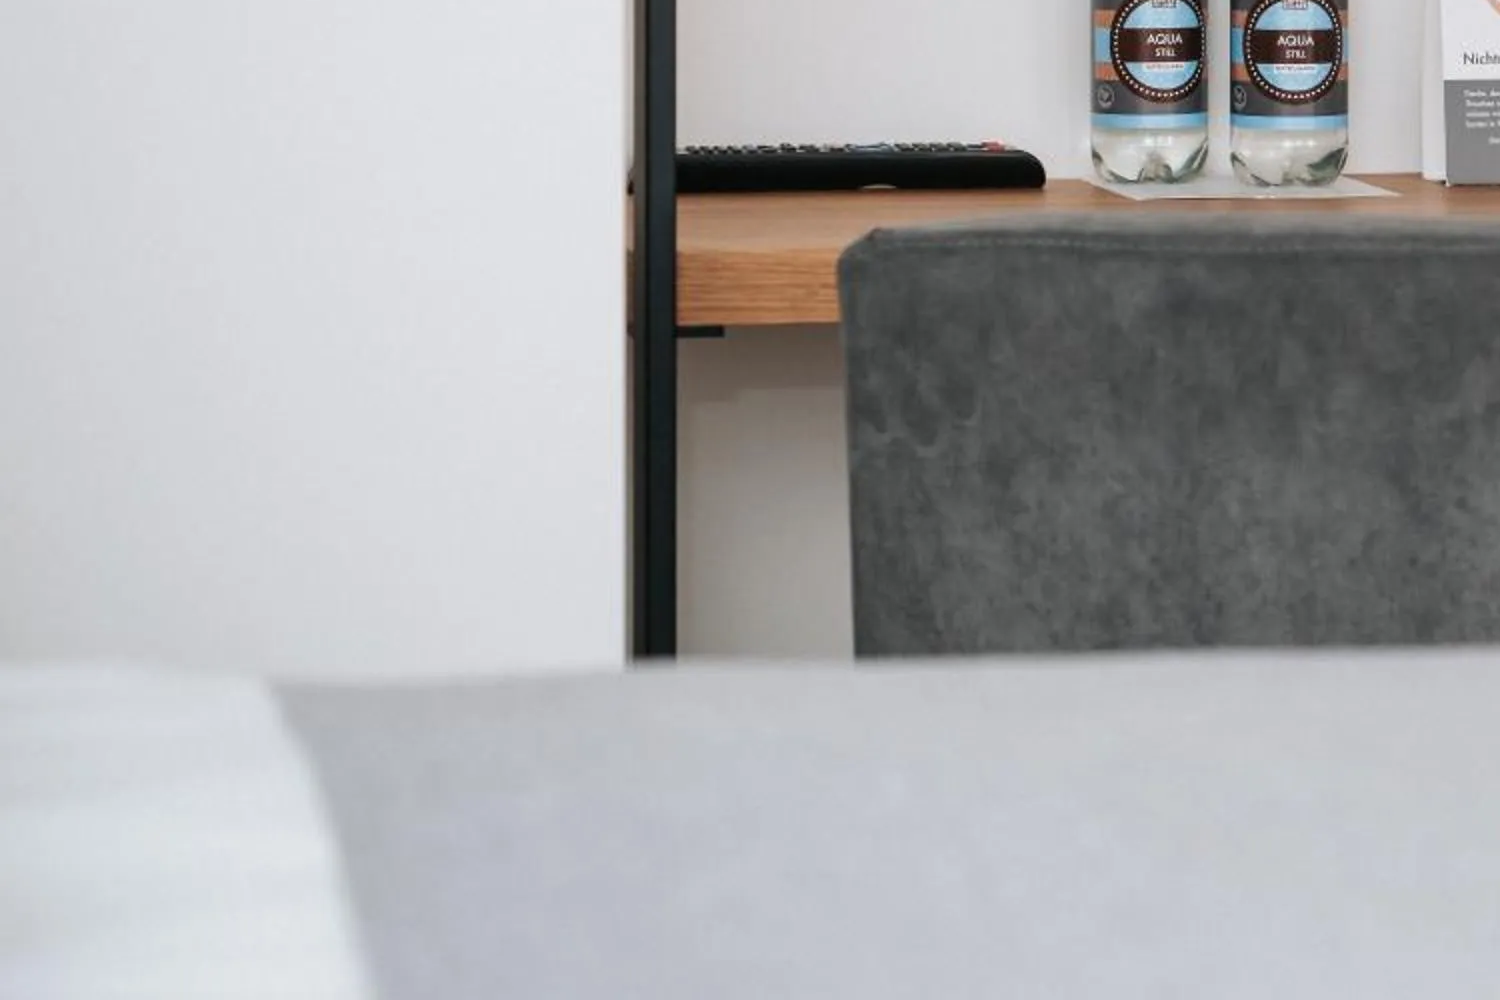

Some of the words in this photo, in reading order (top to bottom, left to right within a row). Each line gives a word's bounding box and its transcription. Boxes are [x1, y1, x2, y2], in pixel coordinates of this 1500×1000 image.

[1147, 34, 1183, 45] AQUA
[1277, 35, 1314, 46] AQUA
[1155, 48, 1176, 57] STILL
[1285, 49, 1307, 59] STILL
